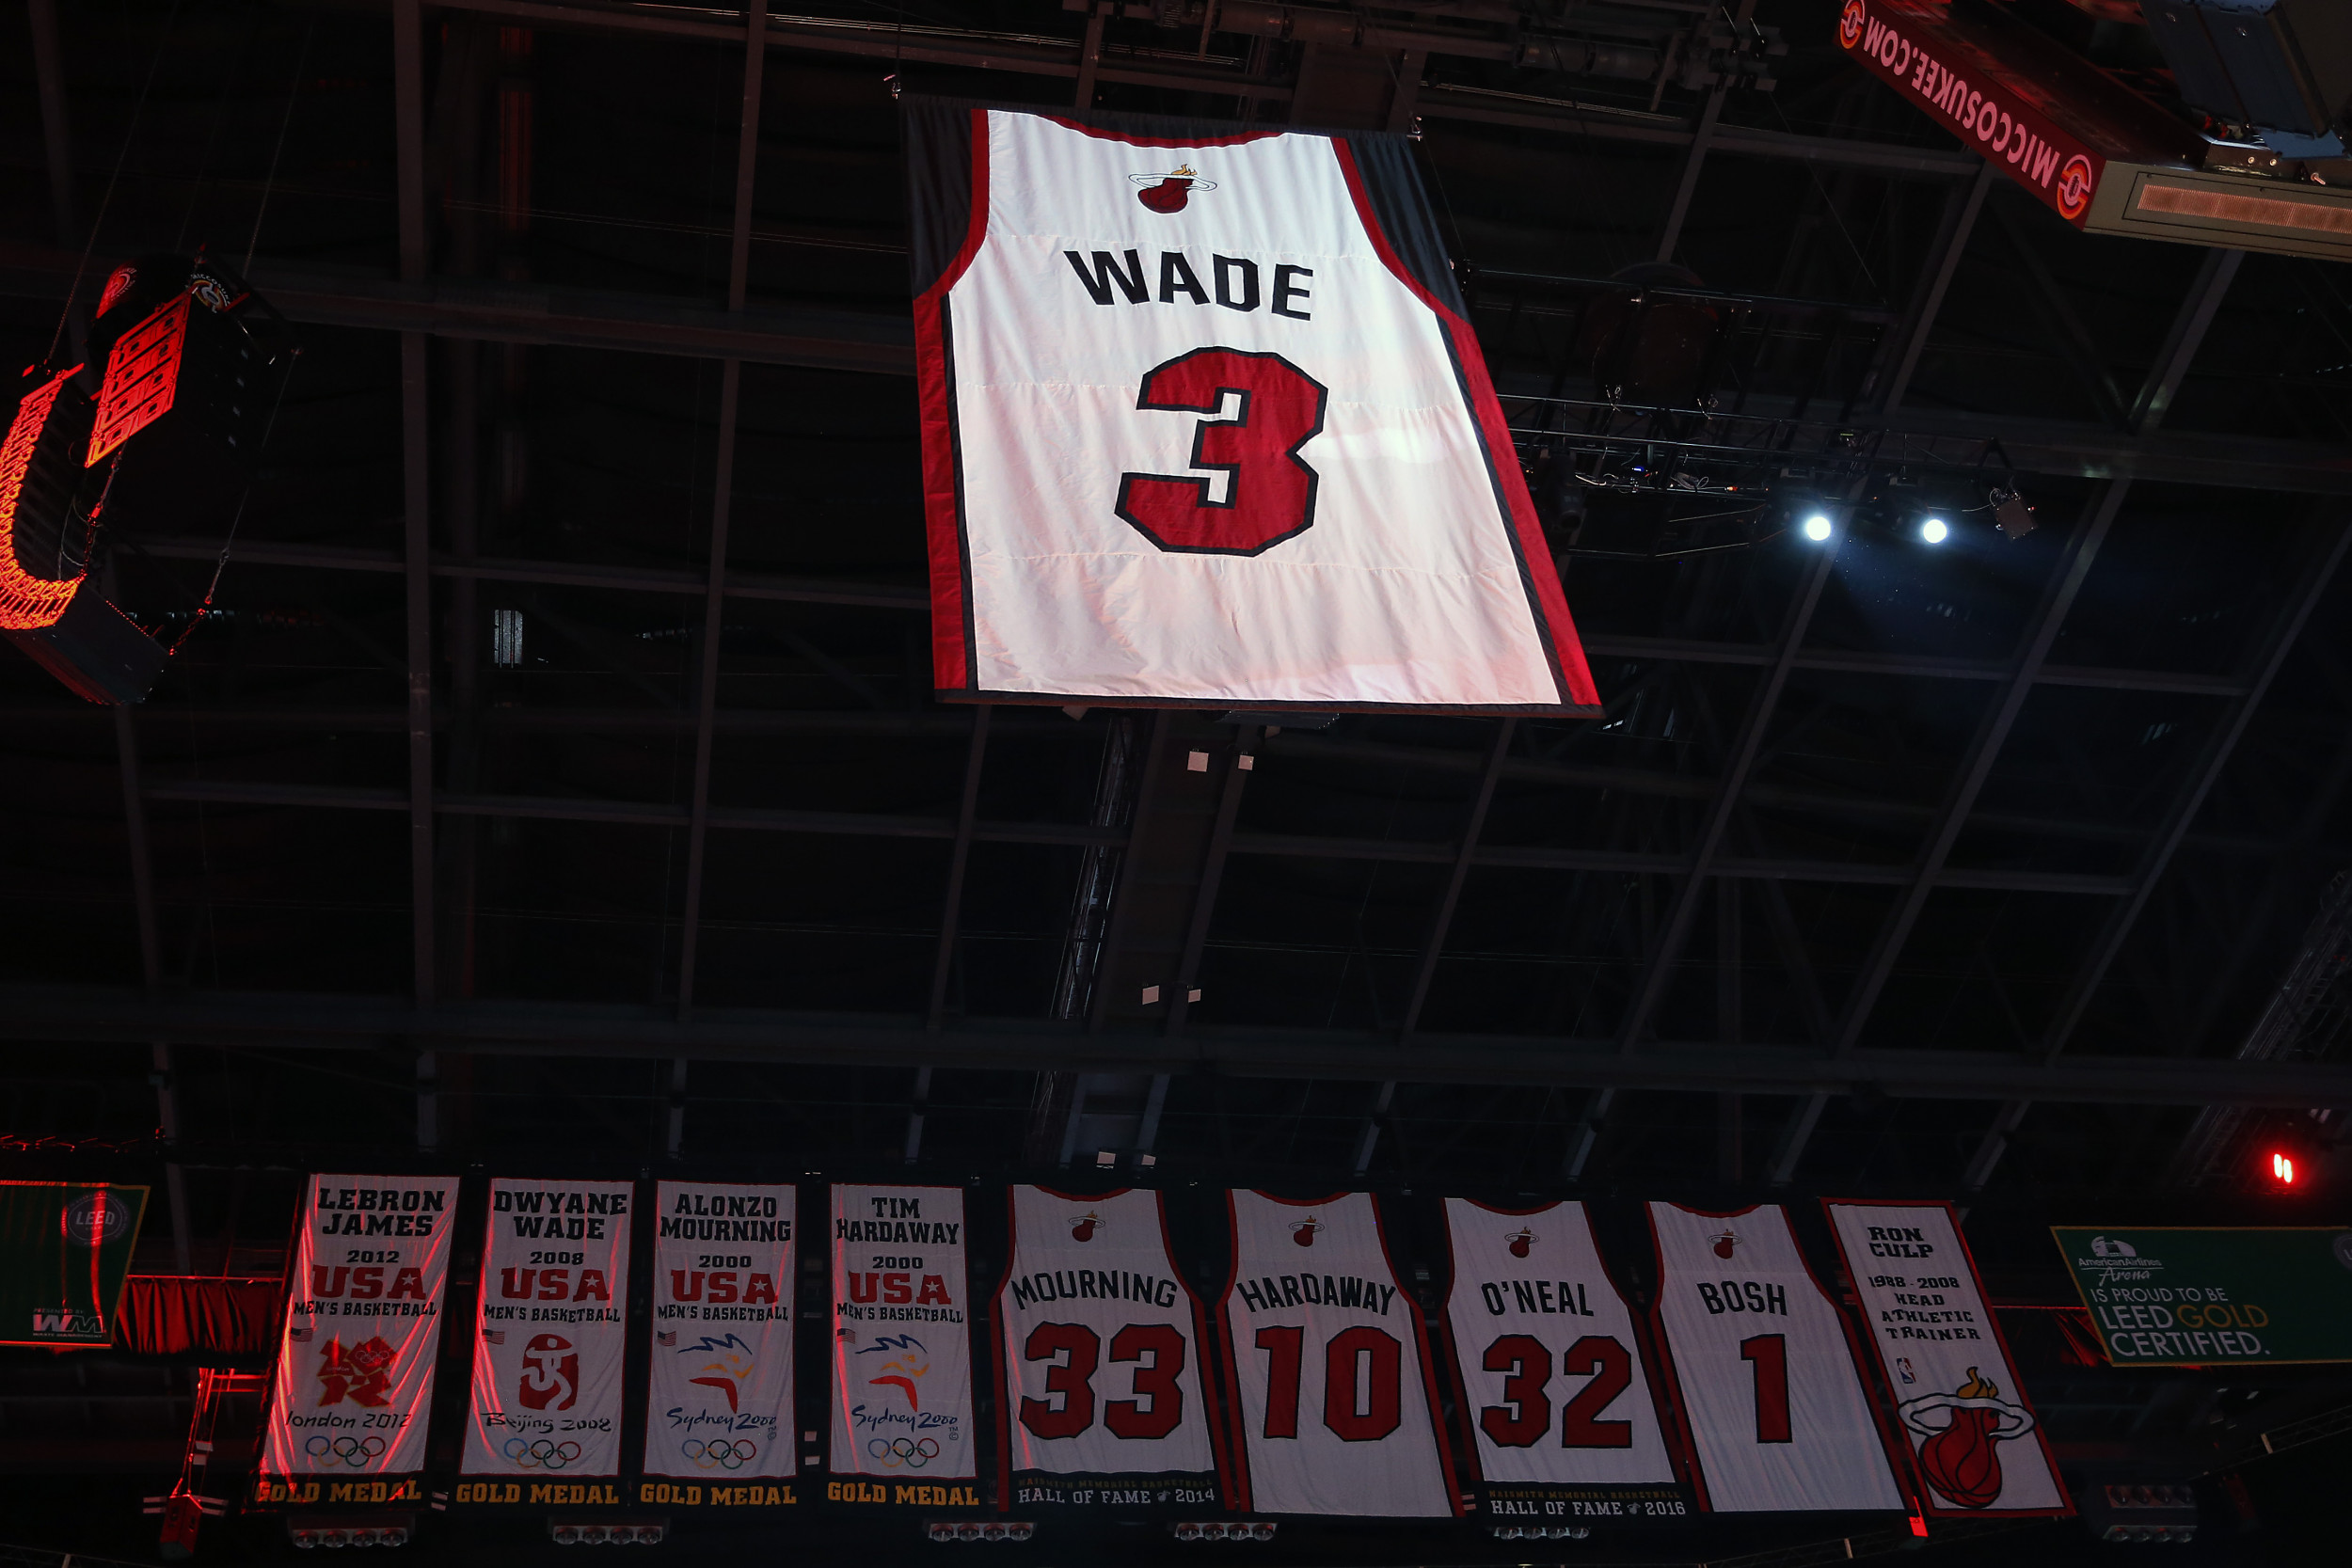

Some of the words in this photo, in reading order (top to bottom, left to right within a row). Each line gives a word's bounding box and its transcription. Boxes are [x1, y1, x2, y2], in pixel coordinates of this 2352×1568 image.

[1865, 15, 2061, 188] MICCOSUKEE.COM
[1063, 250, 1313, 321] WADE
[1114, 345, 1327, 558] 3
[318, 1188, 445, 1212] LEBRON
[493, 1190, 628, 1215] DWYANE
[675, 1194, 777, 1218] ALONZO
[871, 1196, 920, 1219] TIM
[75, 1211, 116, 1226] LEED
[322, 1213, 433, 1237] JAMES
[513, 1216, 605, 1240] WADE
[660, 1216, 791, 1243] MOURNING
[836, 1218, 959, 1244] HARDAWAY
[1867, 1226, 1924, 1243] RON
[346, 1250, 400, 1263] 2012
[530, 1251, 584, 1265] 2008
[698, 1255, 752, 1268] 2000
[872, 1256, 923, 1269] 2000
[1868, 1243, 1933, 1259] CULP
[2078, 1257, 2163, 1268] AmericanAirlines
[311, 1264, 426, 1300] USA
[501, 1267, 611, 1302] USA
[671, 1270, 778, 1305] USA
[848, 1272, 951, 1306] USA
[1868, 1275, 1906, 1289] 1988
[1918, 1276, 1960, 1289] 2008
[2098, 1268, 2152, 1287] Arena
[1010, 1270, 1178, 1310] MOURNING
[1236, 1273, 1397, 1316] HARDAWAY
[1481, 1280, 1594, 1317] O'NEAL
[1697, 1281, 1788, 1316] BOSH
[1895, 1293, 1946, 1306] HEAD
[2090, 1289, 2108, 1303] IS
[2112, 1288, 2173, 1303] PROUD
[2175, 1288, 2201, 1302] TO
[2206, 1288, 2229, 1302] BE
[294, 1301, 338, 1316] MEN'S
[342, 1301, 437, 1317] BASKETBALL
[485, 1304, 527, 1321] MEN'S
[531, 1306, 621, 1323] BASKETBALL
[658, 1305, 699, 1320] MEN'S
[703, 1305, 789, 1323] BASKETBALL
[836, 1303, 875, 1321] MEN'S
[880, 1306, 963, 1323] BASKETBALL
[1882, 1309, 1974, 1323] ATHLETIC
[2098, 1305, 2174, 1330] LEED
[2176, 1304, 2270, 1329] GOLD
[1885, 1326, 1981, 1341] TRAINER
[2110, 1331, 2271, 1356] CERTIFIED.
[1020, 1321, 1186, 1440] 33
[1255, 1325, 1402, 1441] 10
[1480, 1334, 1632, 1449] 32
[1740, 1333, 1792, 1444] 1
[285, 1411, 356, 1428] london
[362, 1413, 411, 1428] 2012
[481, 1412, 553, 1433] Beijing
[560, 1418, 612, 1432] 2008
[666, 1407, 734, 1433] Sydney
[735, 1414, 777, 1430] 2000
[851, 1405, 915, 1433] Sydney
[917, 1413, 958, 1429] 2000
[253, 1481, 321, 1504] GOLD
[328, 1479, 422, 1503] MEDAL
[455, 1483, 521, 1504] GOLD
[529, 1483, 620, 1505] MEDAL
[640, 1483, 702, 1505] GOLD
[710, 1485, 798, 1506] MEDAL
[827, 1481, 887, 1504] GOLD
[896, 1485, 979, 1506] MEDAL
[1018, 1488, 1065, 1504] HALL
[1073, 1489, 1094, 1504] OF
[1101, 1490, 1152, 1504] FAME
[1175, 1488, 1215, 1503] 2014
[1490, 1500, 1539, 1514] HALL
[1545, 1500, 1565, 1514] OF
[1572, 1501, 1623, 1515] FAME
[1645, 1501, 1686, 1515] 2016
